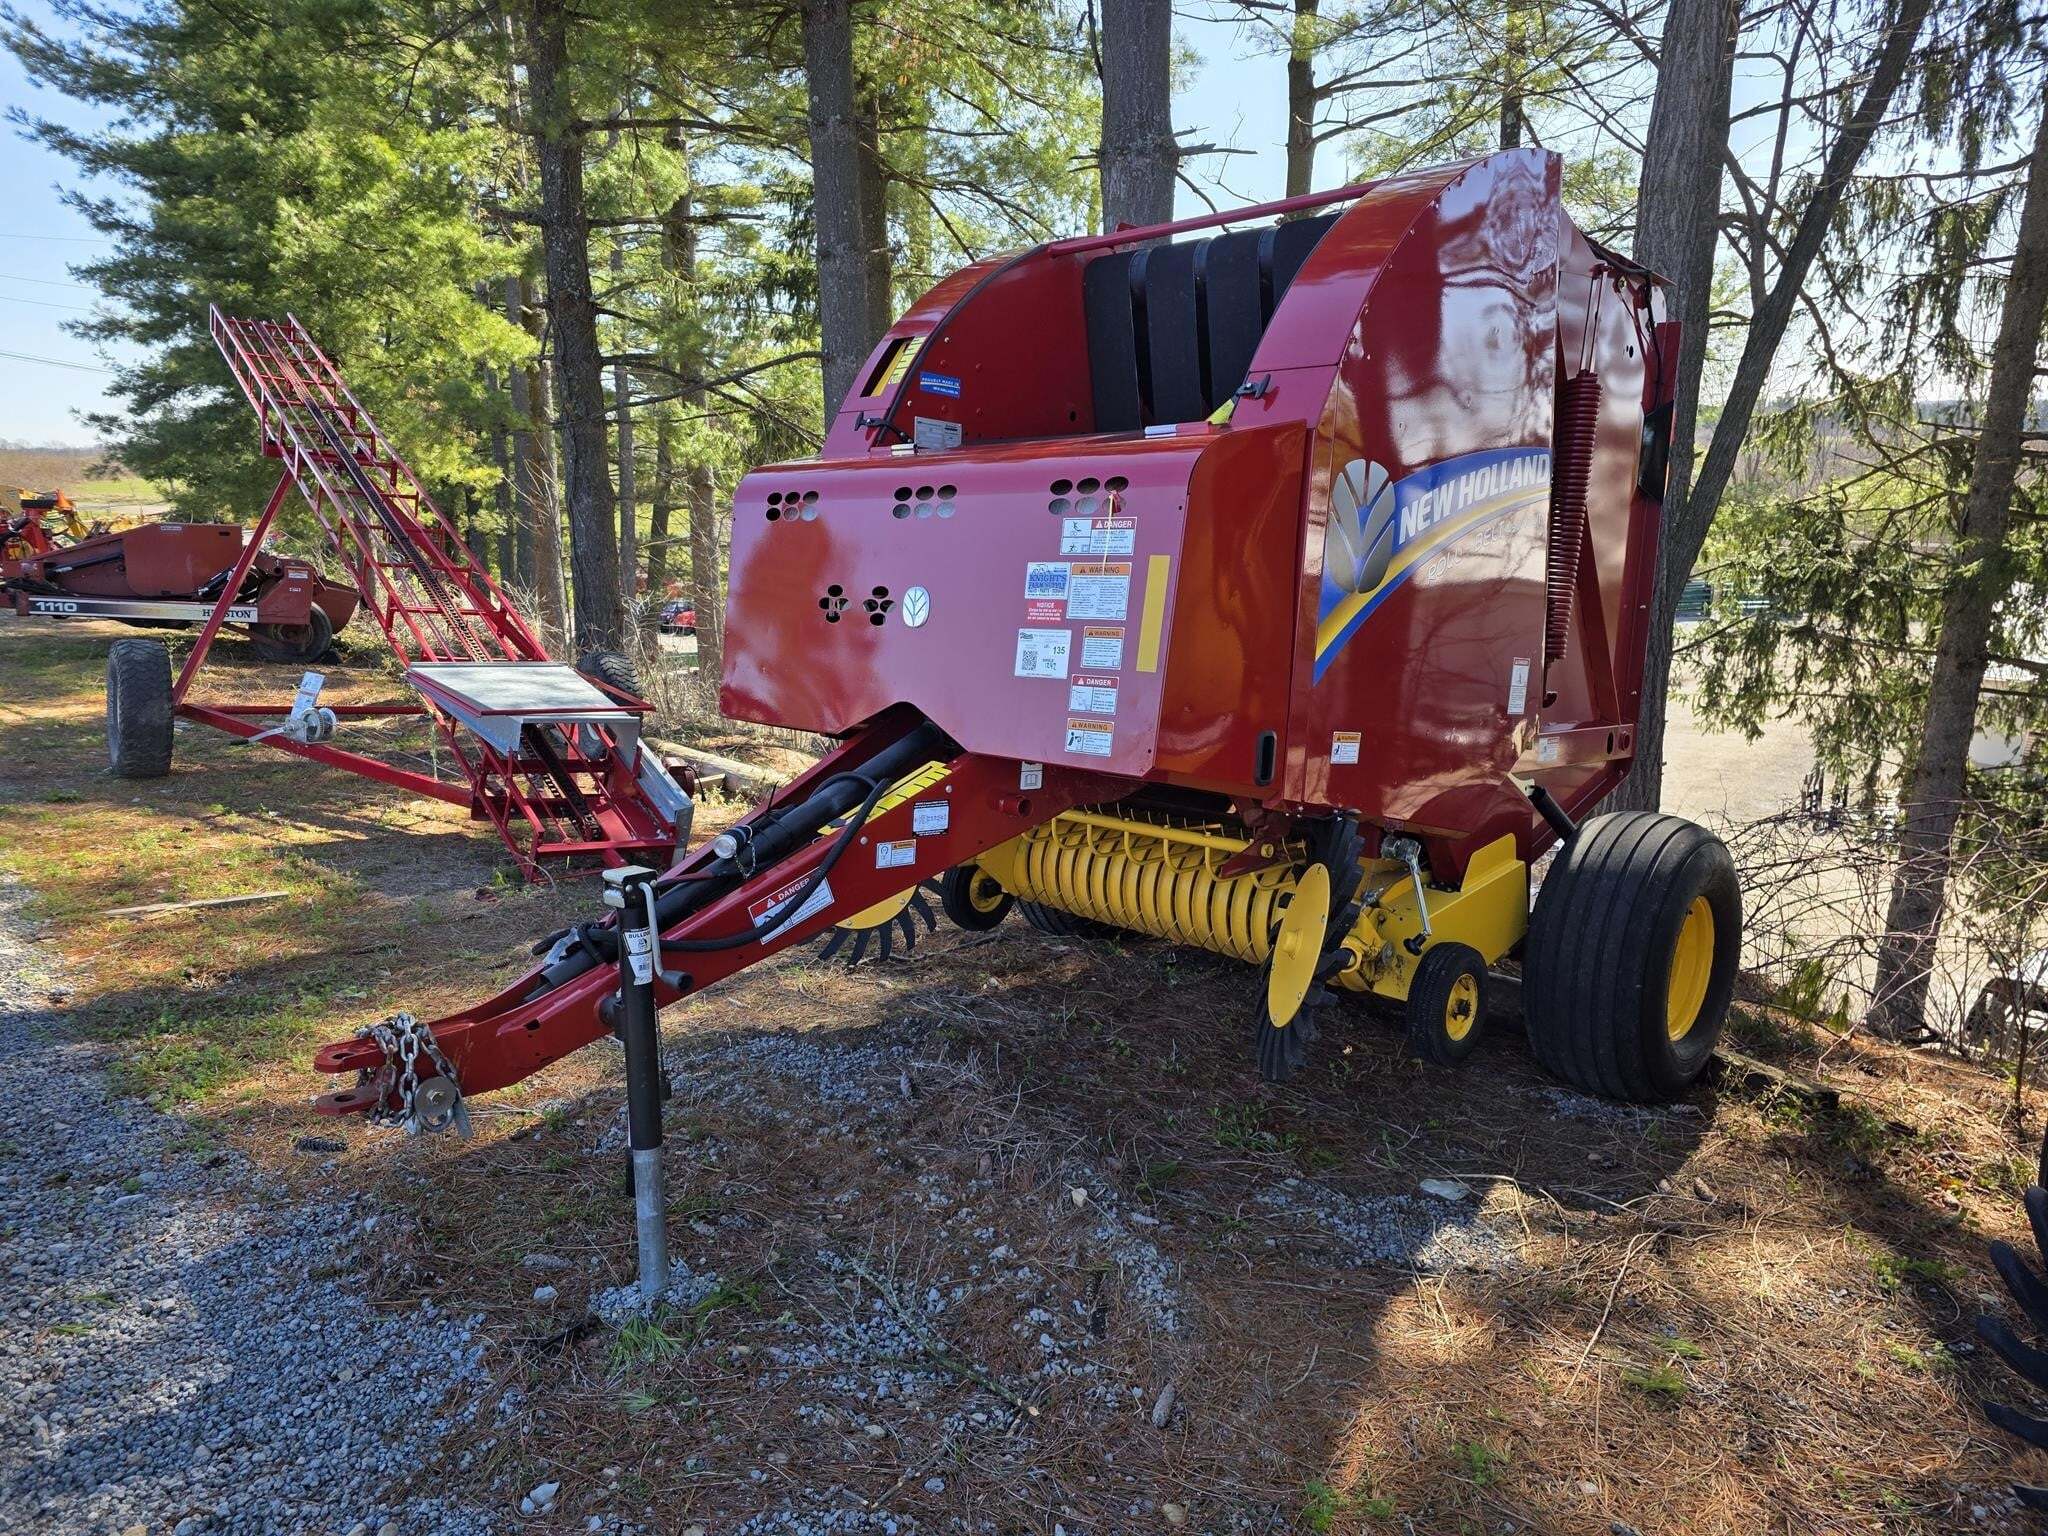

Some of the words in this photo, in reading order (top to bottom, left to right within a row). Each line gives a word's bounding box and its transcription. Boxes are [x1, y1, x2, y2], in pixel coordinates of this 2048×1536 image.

[1398, 483, 1457, 545] NEW
[1457, 454, 1550, 509] HOLLAND
[35, 601, 78, 612] 1110
[202, 608, 252, 619] HSTON
[1053, 646, 1066, 655] 135
[1086, 678, 1112, 686] DANGER
[1077, 723, 1108, 731] WARNING
[777, 877, 810, 901] DANGER
[628, 931, 651, 939] BULLDO
